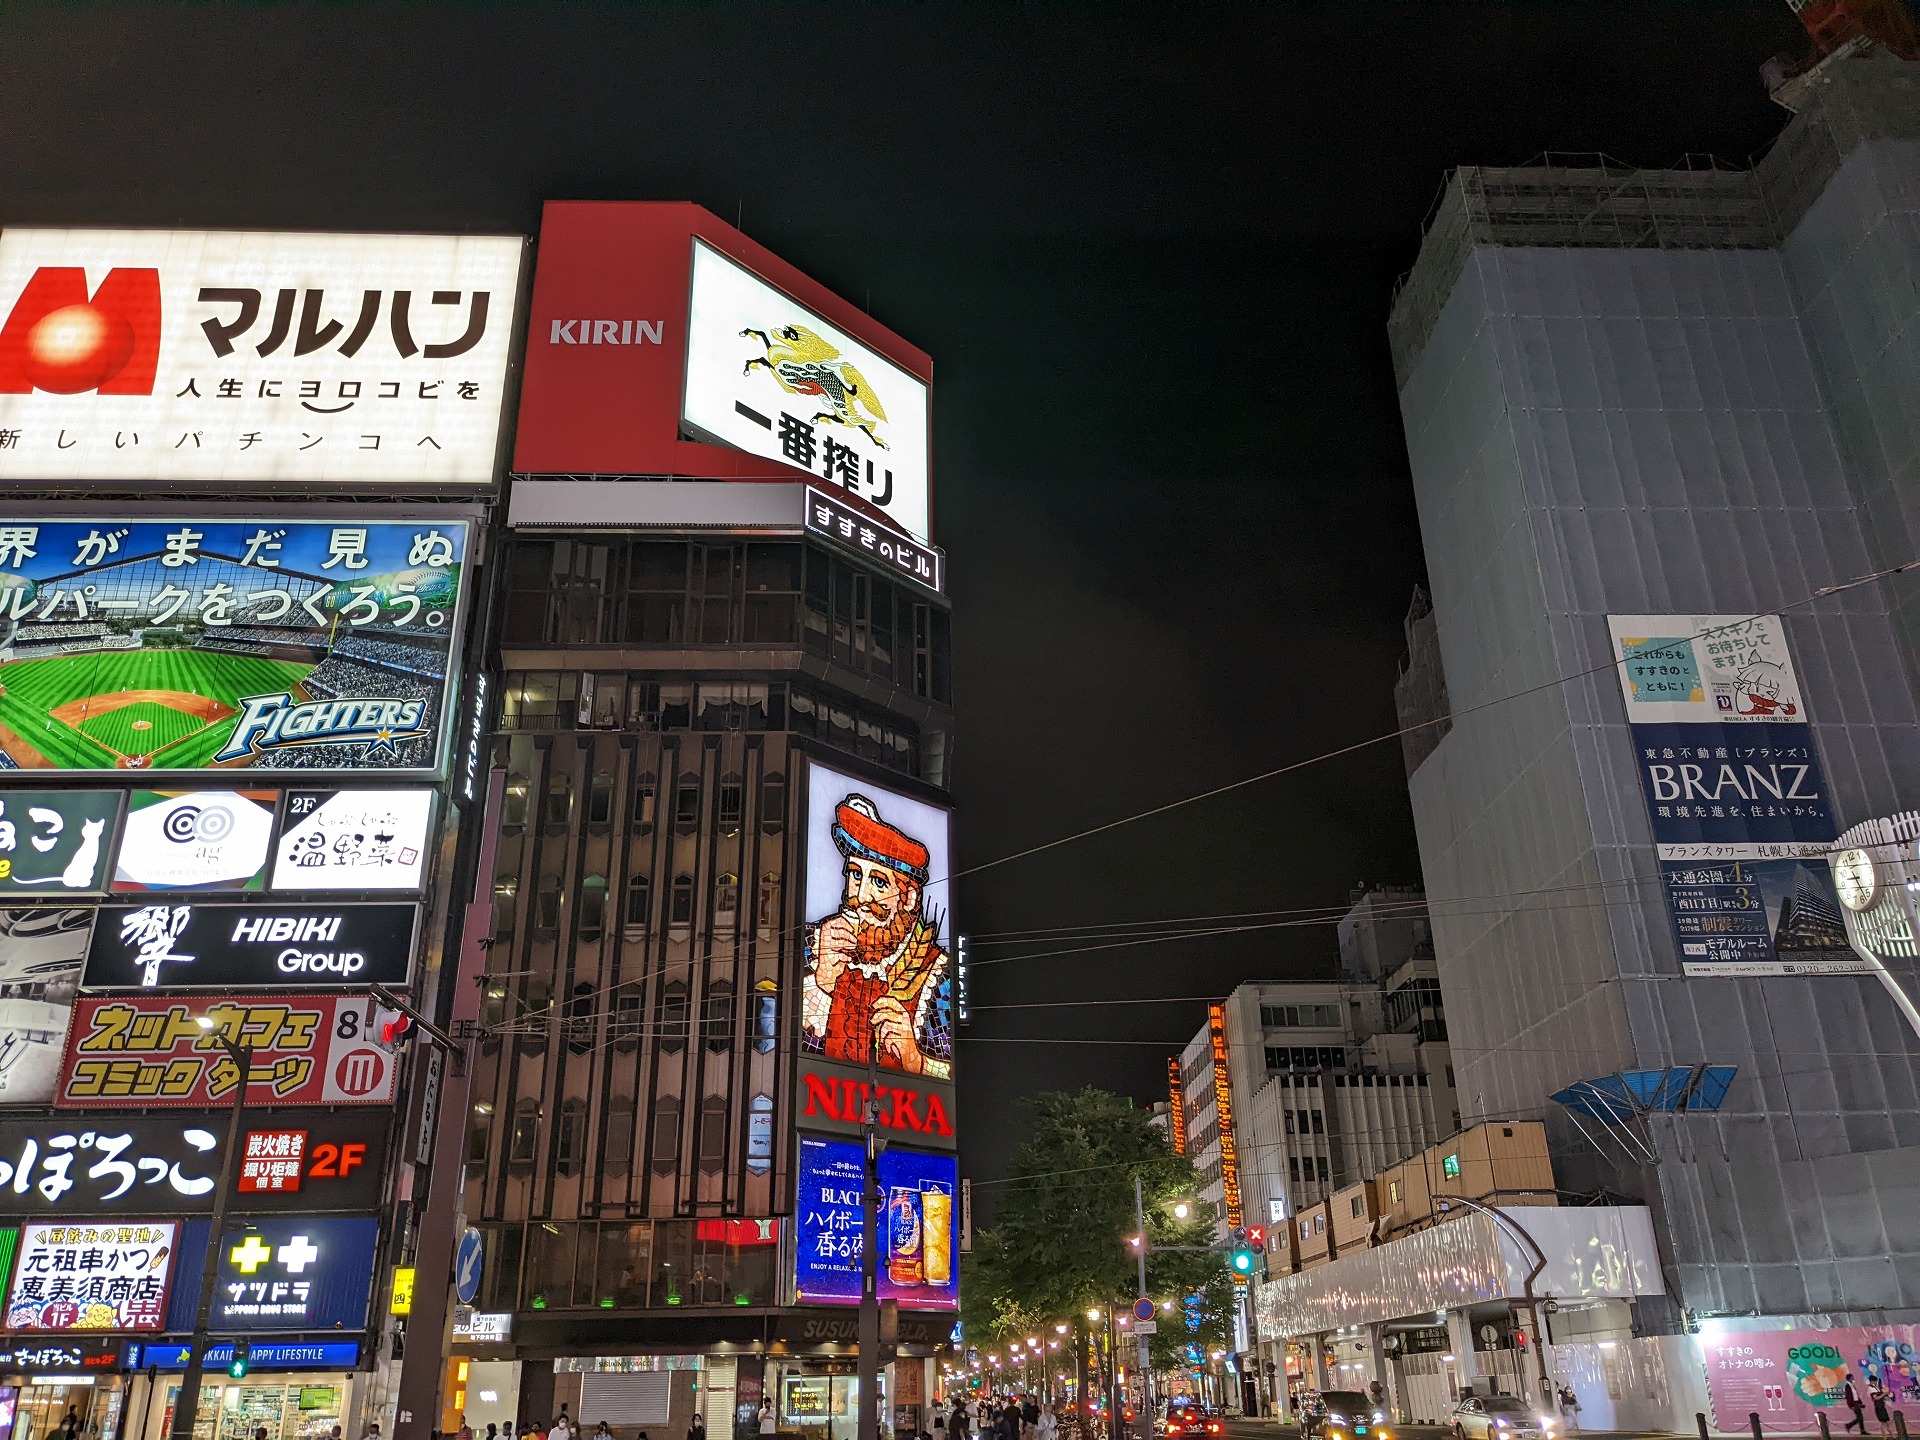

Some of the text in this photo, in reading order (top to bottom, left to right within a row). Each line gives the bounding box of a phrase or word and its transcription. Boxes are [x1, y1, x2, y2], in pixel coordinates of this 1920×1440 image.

[198, 288, 490, 359] マルハン
[550, 319, 664, 345] KIRIN
[176, 378, 480, 400] 人生にヨロコビを
[0, 429, 442, 451] 新しいパチンコへ
[734, 400, 892, 506] 一番搾り
[815, 504, 930, 578] すすきのビル
[1700, 620, 1764, 641] ススキノで
[1634, 650, 1685, 660] これからも
[1706, 634, 1771, 655] お待ちして
[1635, 666, 1690, 676] すすきのと
[214, 693, 427, 762] FIGHTERS
[1649, 764, 1818, 801] BRANZ
[290, 797, 316, 813] 2F
[289, 830, 396, 867] 温野菜
[1664, 846, 1748, 857] ブランズタワー
[1668, 871, 1724, 884] 大通公園
[231, 918, 342, 942] HIBIKI
[1705, 938, 1767, 949] モデルルーム
[278, 948, 364, 976] Group
[1709, 950, 1741, 960] 公開中
[80, 1005, 321, 1051] ネットカフェ
[67, 1060, 203, 1096] コミック
[802, 1072, 954, 1137] NIKKA
[247, 1134, 304, 1156] 炭火焼き
[309, 1144, 366, 1177] 2F
[256, 1177, 284, 1188] 個室
[805, 1209, 864, 1231] ハイボー
[49, 1227, 151, 1244] 昼飲みの聖地
[24, 1247, 150, 1273] 元祖串かつ
[17, 1275, 161, 1301] 恵美須商店
[227, 1282, 310, 1302] サツドラ
[51, 1313, 70, 1327] 1F
[260, 1304, 281, 1315] DRUG
[282, 1303, 307, 1315] STORE
[15, 1348, 81, 1366] さっぽろっこ
[248, 1349, 274, 1361] APPY
[276, 1348, 324, 1360] LIFESTYLE
[1716, 1346, 1753, 1357] すすきの
[1787, 1346, 1841, 1360] GOOD!
